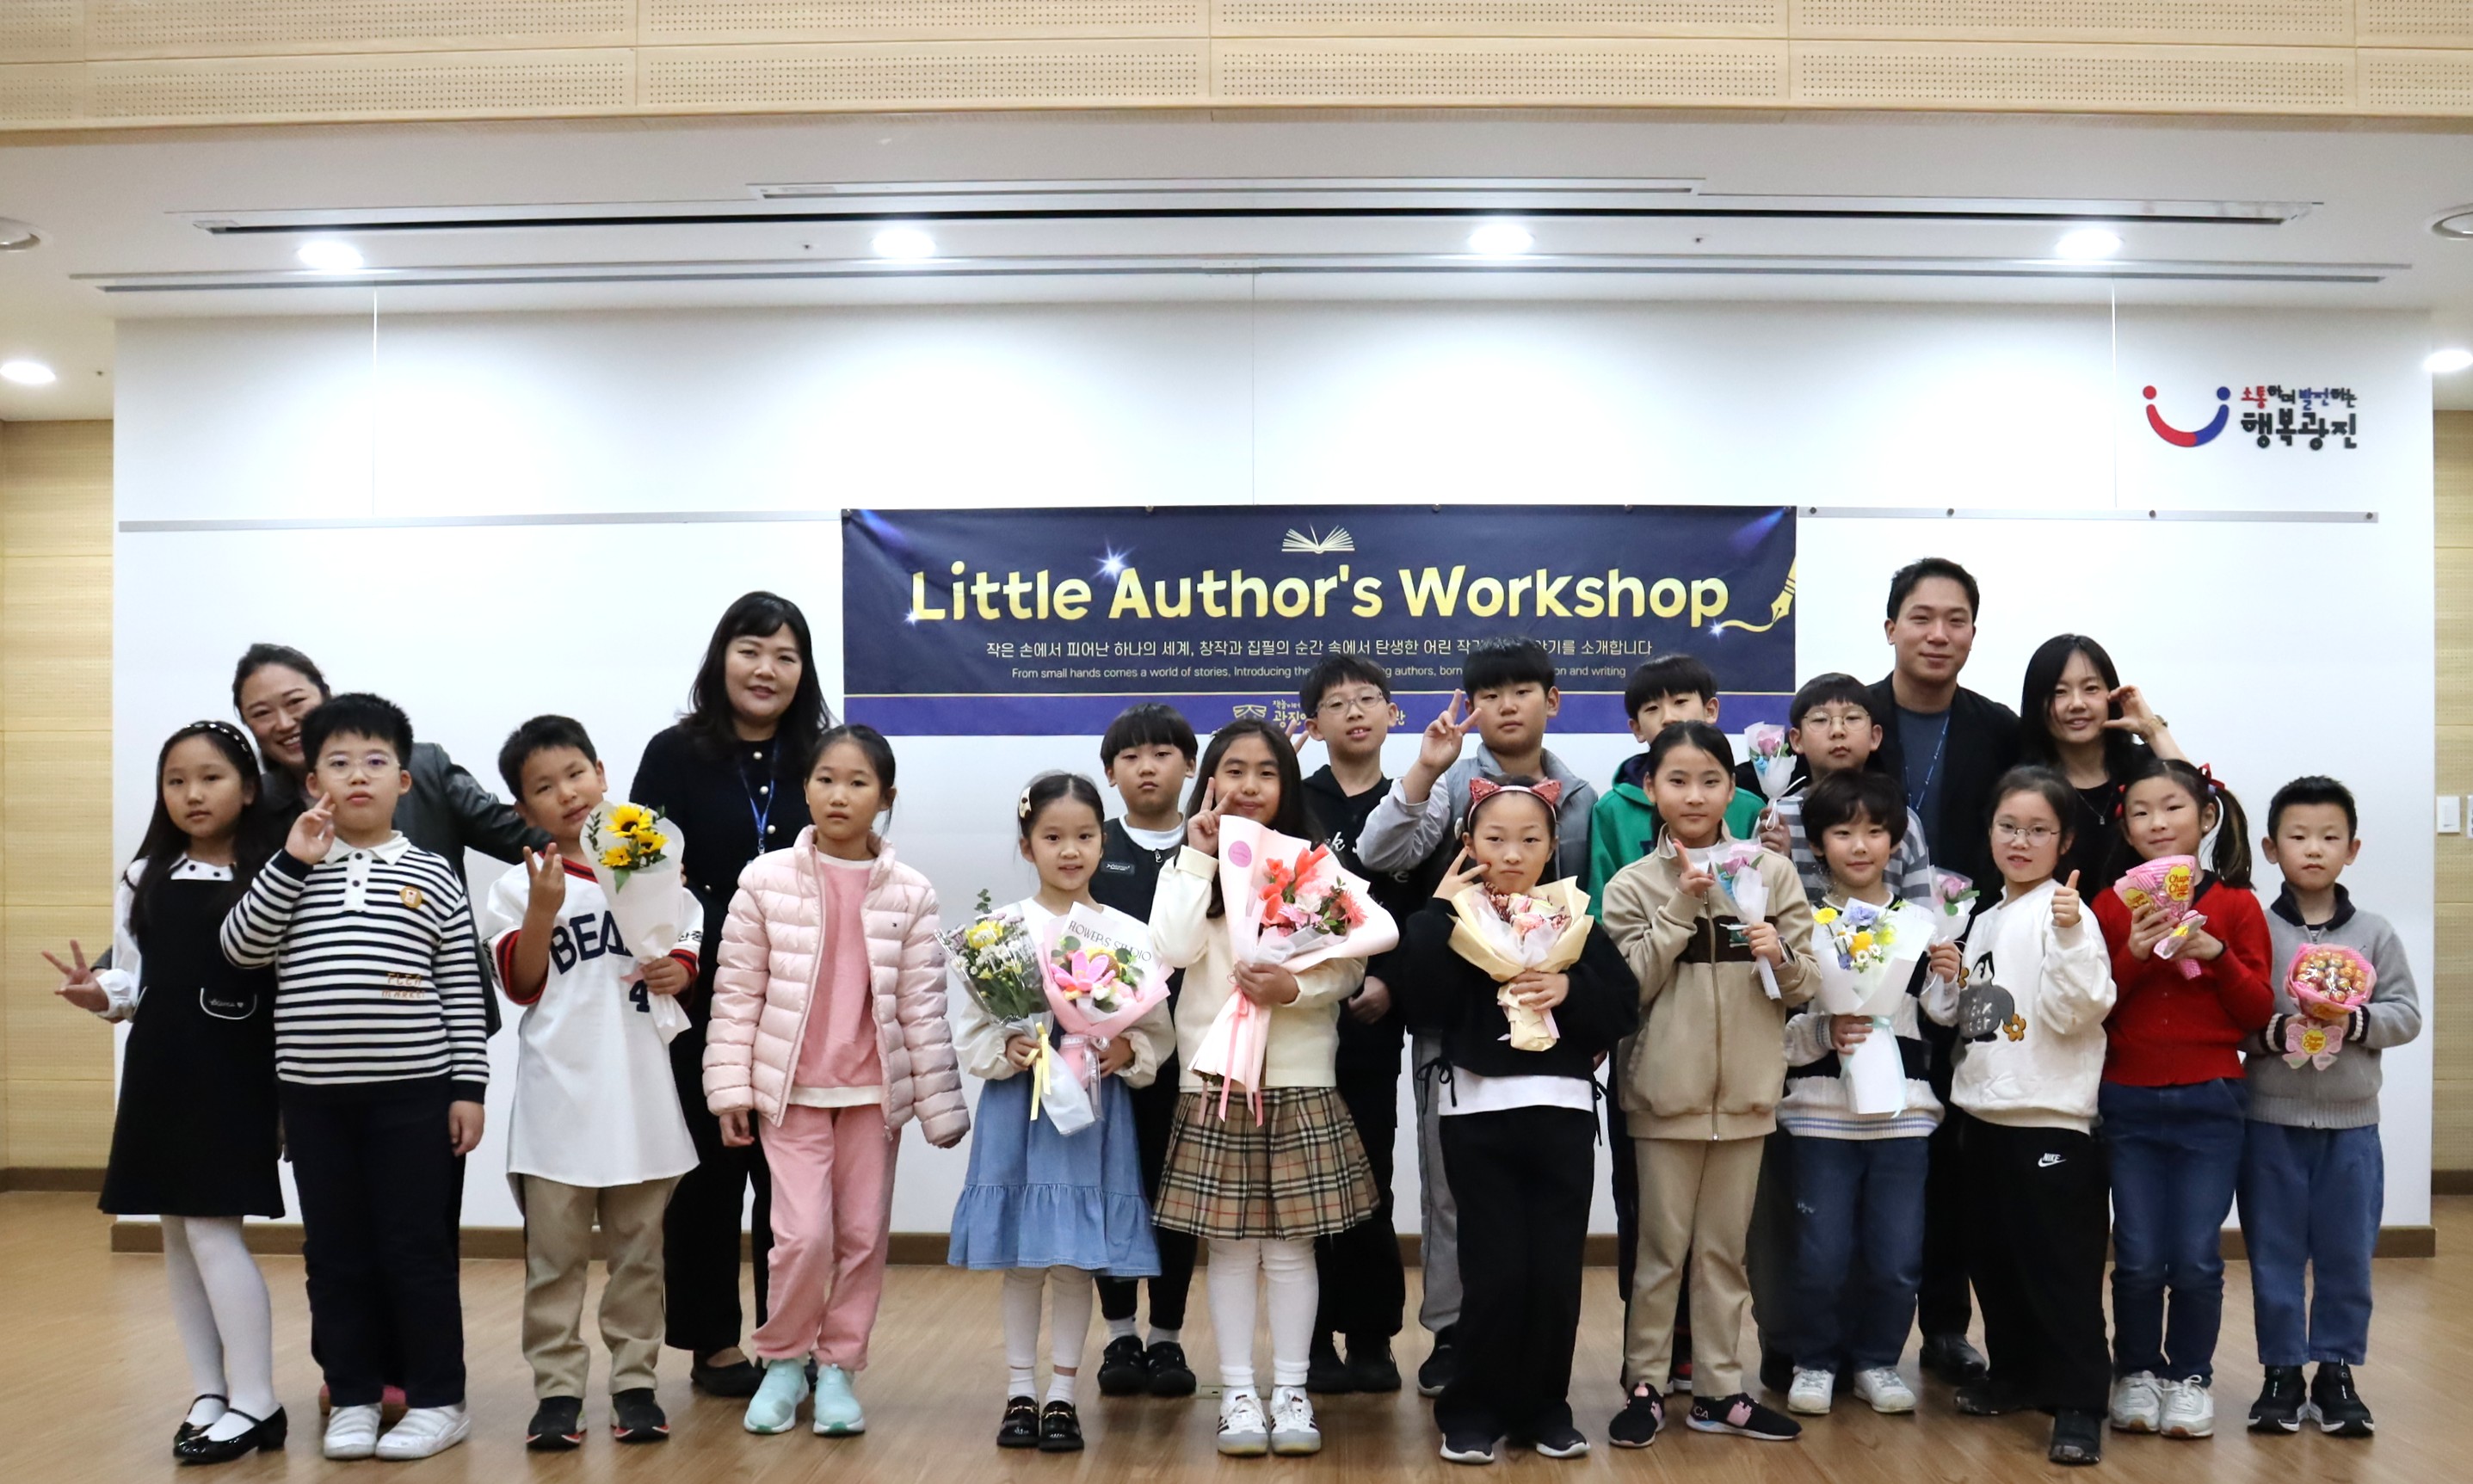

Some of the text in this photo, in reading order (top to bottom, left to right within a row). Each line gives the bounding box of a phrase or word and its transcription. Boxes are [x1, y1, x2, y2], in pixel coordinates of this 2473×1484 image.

[2241, 408, 2357, 450] 행복광진
[912, 561, 1729, 627] Little Author's Workshop
[986, 642, 1014, 657] 작은
[1020, 642, 1061, 657] 손에서
[1067, 642, 1109, 657] 피어난
[1114, 641, 1156, 656] 하나의
[1162, 641, 1194, 656] 세계,
[1199, 641, 1243, 656] 창작과
[1248, 640, 1289, 656] 집필의
[1295, 640, 1323, 656] 순간
[1329, 640, 1370, 655] 속에서
[1376, 640, 1418, 655] 탄생한
[1424, 640, 1452, 655] 어린
[1581, 640, 1652, 655] 소개합니다
[1012, 668, 1039, 678] From
[1041, 668, 1067, 678] small
[1070, 668, 1101, 678] hands
[1104, 669, 1138, 678] comes
[1150, 668, 1178, 677] world
[1181, 667, 1191, 677] of
[1194, 667, 1230, 678] stories,
[1234, 666, 1292, 679] Introducing
[1395, 666, 1436, 677] authors,
[1440, 666, 1463, 675] born
[1570, 666, 1588, 676] and
[1592, 666, 1626, 678] writing
[550, 910, 633, 975] BEA
[387, 972, 422, 986] FLEA
[2042, 1152, 2062, 1162] NIKE
